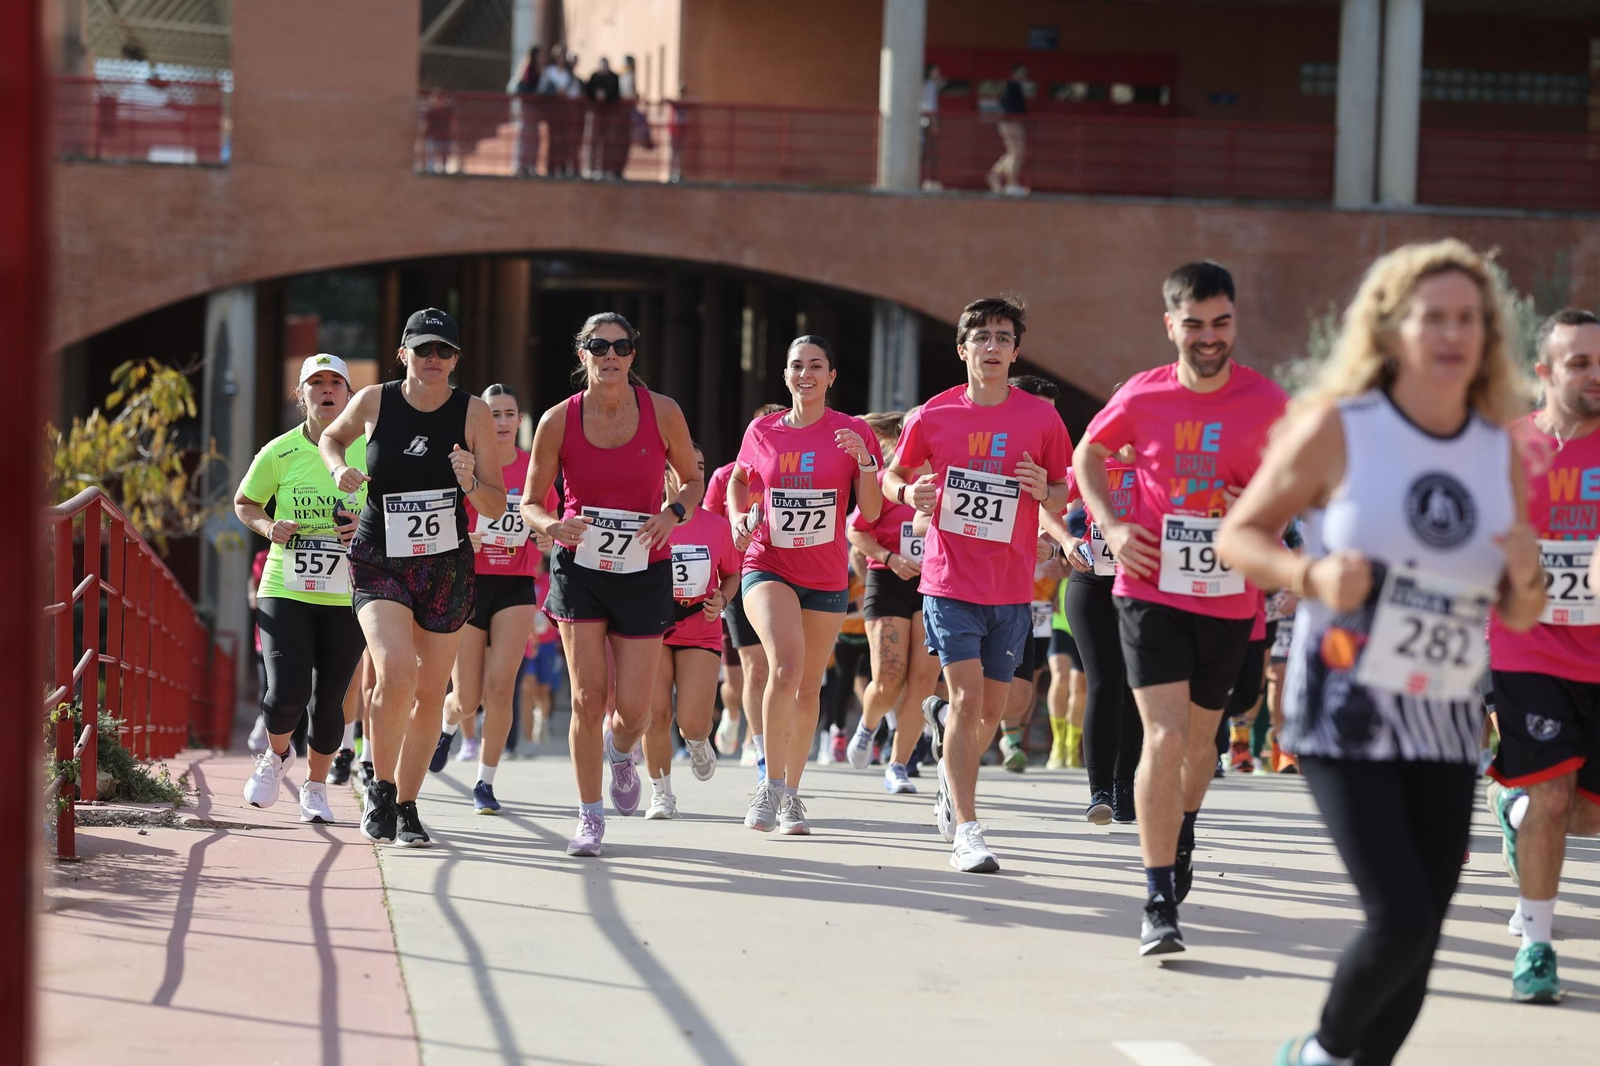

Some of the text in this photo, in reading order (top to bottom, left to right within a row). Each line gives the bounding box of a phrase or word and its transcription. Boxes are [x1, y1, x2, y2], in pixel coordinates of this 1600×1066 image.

[968, 431, 1008, 457] WE
[1174, 421, 1222, 453] WE
[779, 451, 816, 473] WE
[1174, 454, 1216, 477] RUN
[949, 477, 982, 492] UMA
[1547, 466, 1600, 501] WE
[293, 495, 337, 507] YO NO
[388, 502, 421, 512] UMA
[773, 498, 803, 508] UMA
[954, 492, 1004, 523] 281
[1111, 490, 1131, 507] UN
[407, 513, 440, 538] 26
[487, 514, 524, 533] 203
[781, 509, 827, 532] 272
[1550, 504, 1598, 530] RUN
[964, 525, 977, 534] WE
[1168, 528, 1207, 541] UMA
[288, 541, 316, 549] UMA
[598, 531, 633, 556] 27
[294, 552, 341, 576] 557
[1539, 554, 1568, 567] MA
[675, 563, 689, 583] 3
[1394, 617, 1471, 667] 282
